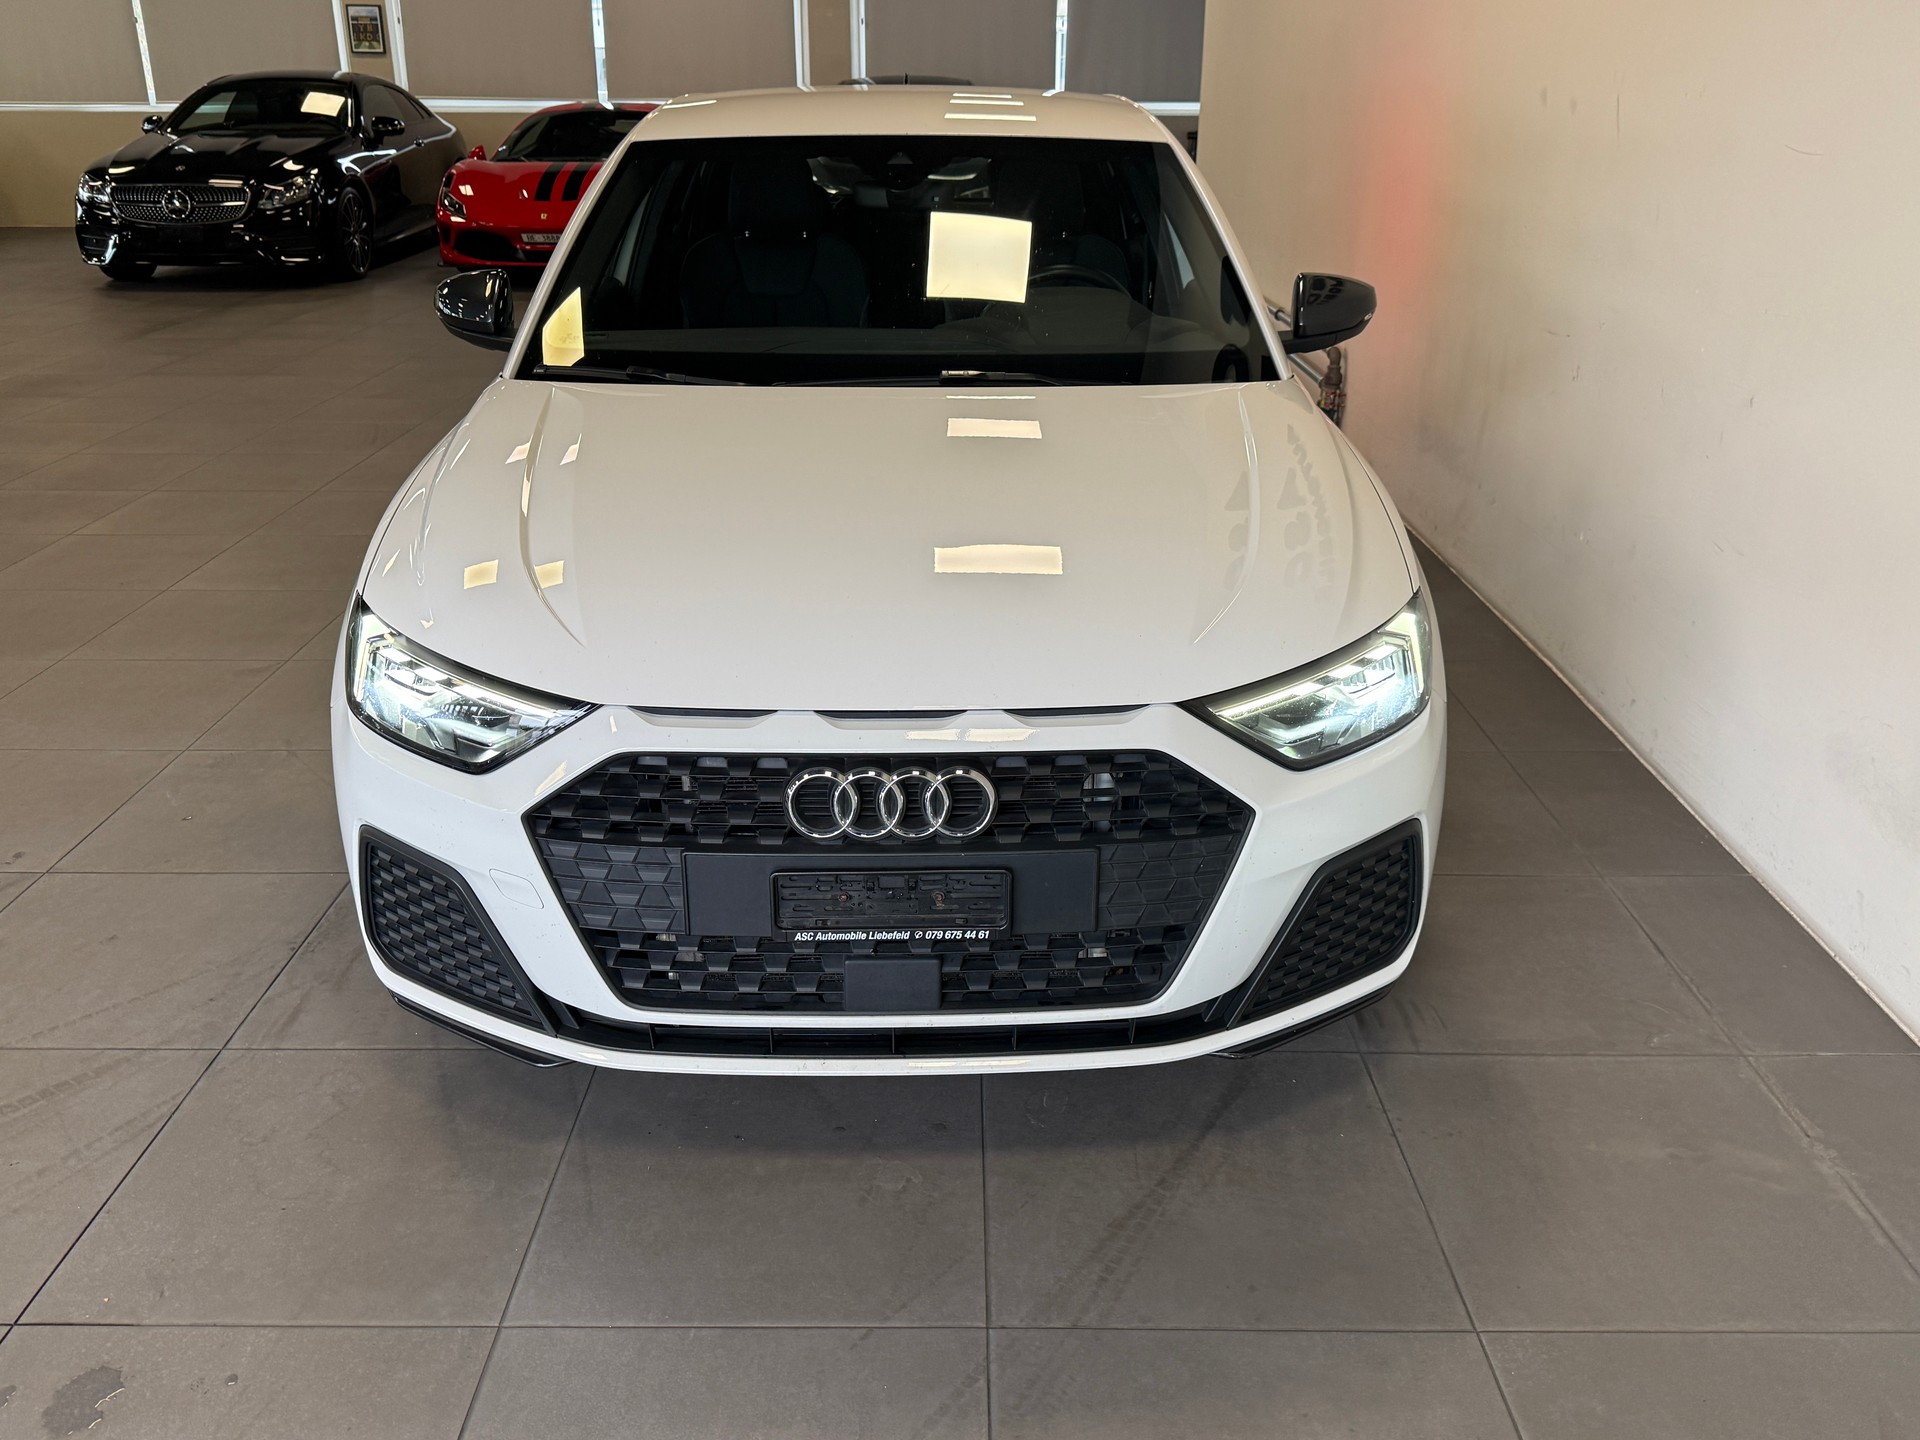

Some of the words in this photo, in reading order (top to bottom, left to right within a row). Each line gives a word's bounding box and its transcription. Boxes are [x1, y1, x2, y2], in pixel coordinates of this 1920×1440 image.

[794, 932, 814, 941] ASC
[815, 931, 867, 941] Automobile
[868, 930, 911, 940] Liebefeld
[925, 930, 944, 940] 079
[944, 930, 963, 940] 675
[964, 930, 977, 940] 44
[978, 930, 990, 940] 61
